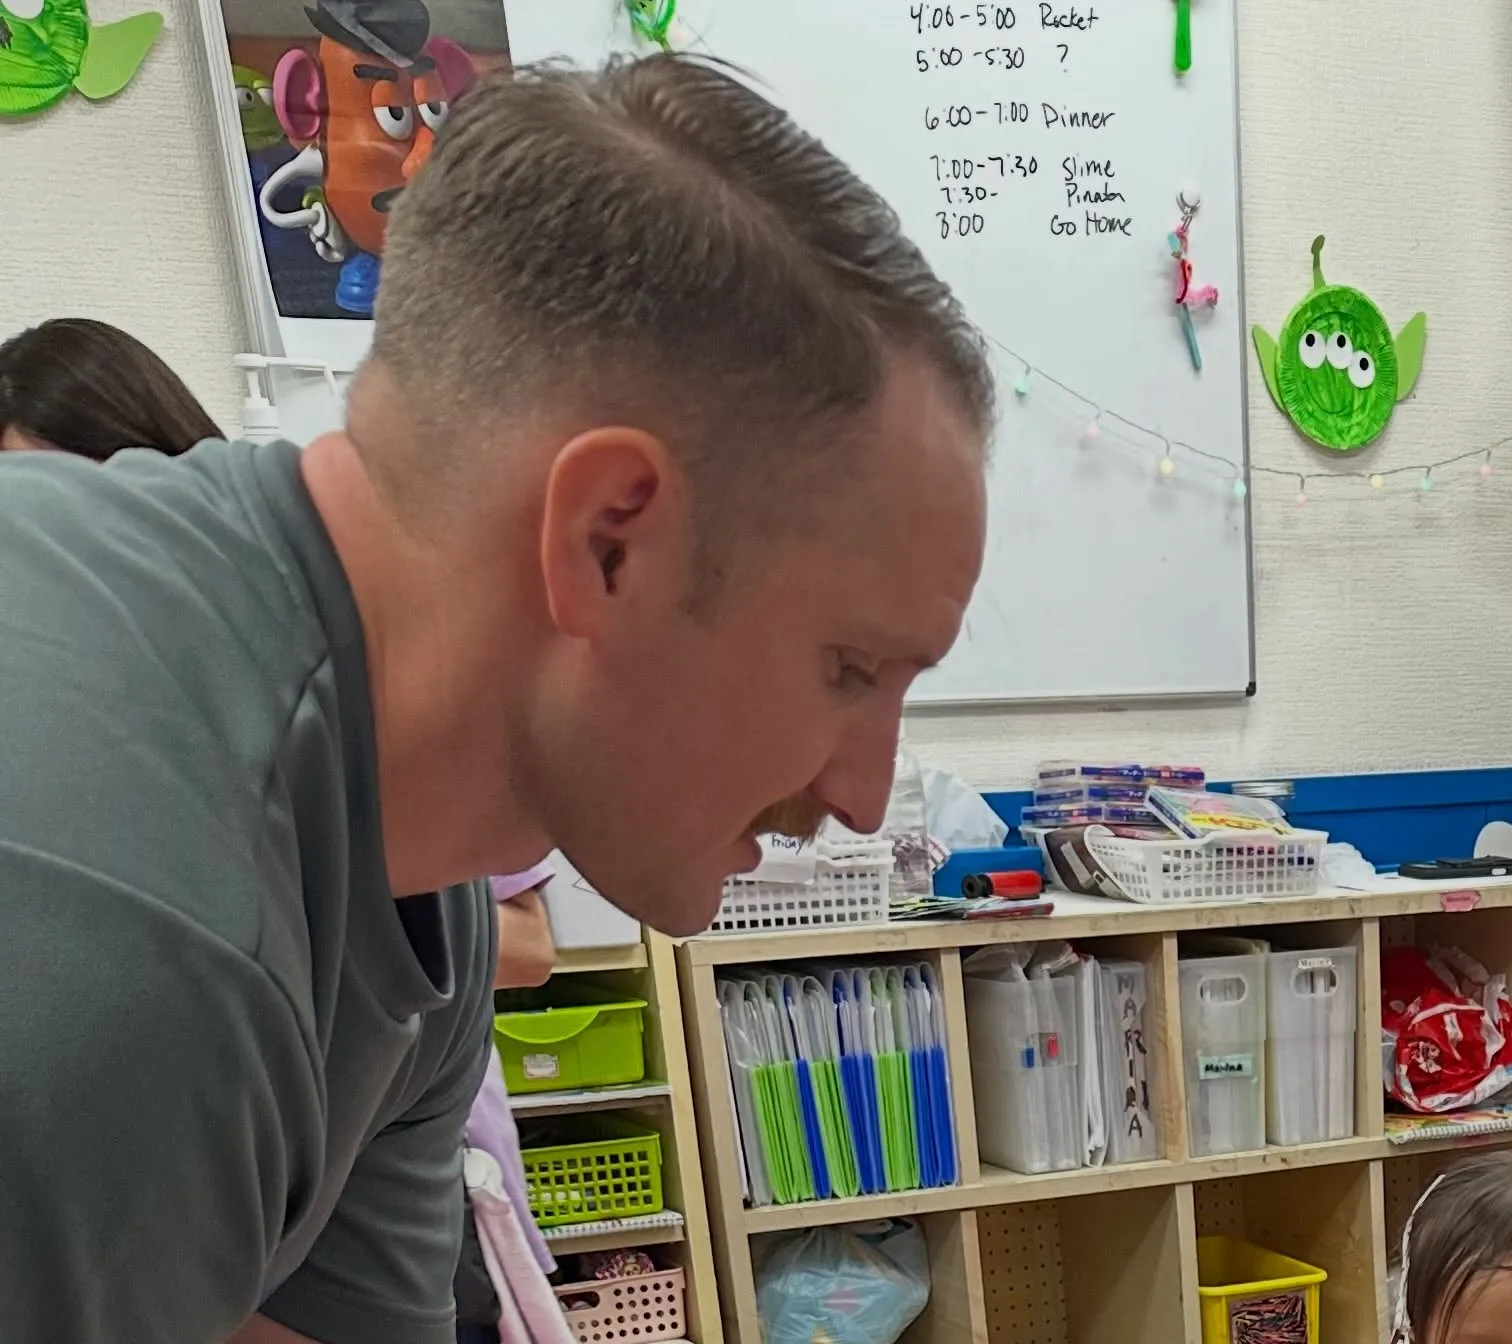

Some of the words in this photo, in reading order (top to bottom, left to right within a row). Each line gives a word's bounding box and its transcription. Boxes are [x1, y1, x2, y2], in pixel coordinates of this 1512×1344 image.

[1038, 2, 1100, 31] Rocket
[1056, 43, 1069, 73] ?
[1041, 102, 1116, 130] Dinner
[1062, 152, 1116, 182] Slime
[935, 211, 985, 240] 8:00
[1050, 214, 1077, 236] Go
[1085, 210, 1132, 237] Home
